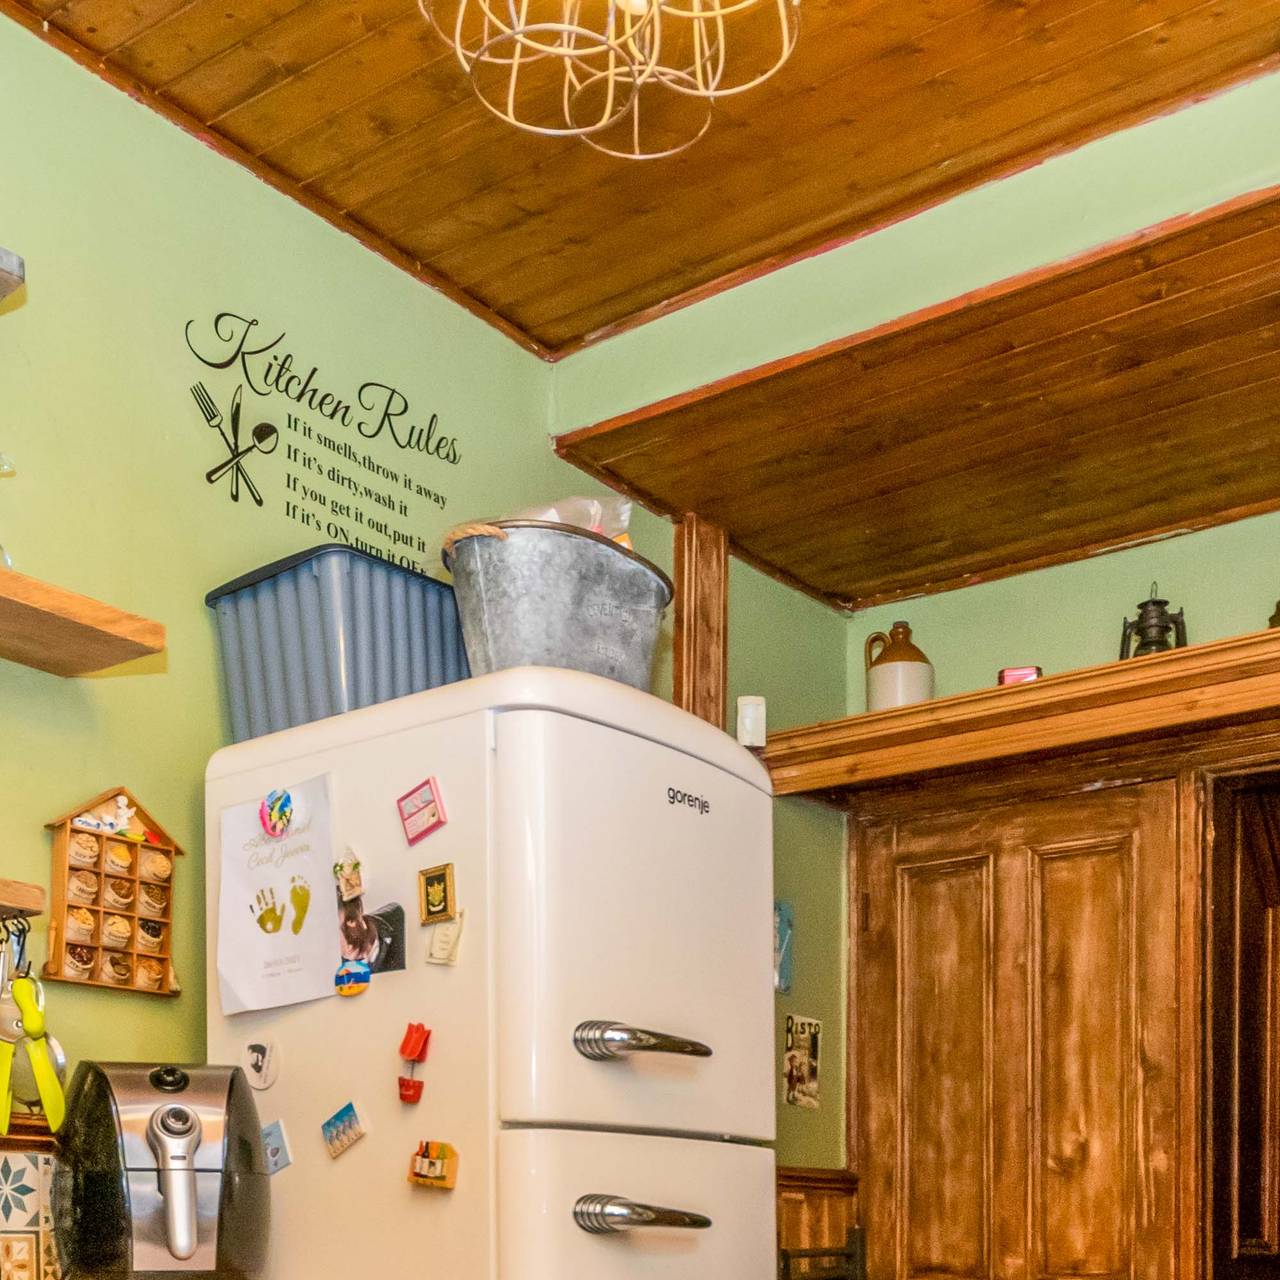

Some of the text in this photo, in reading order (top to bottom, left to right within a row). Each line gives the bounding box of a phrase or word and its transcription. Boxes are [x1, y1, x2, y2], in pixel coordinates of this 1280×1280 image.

[185, 312, 462, 465] Kitchen Rules
[287, 413, 299, 432] If
[303, 422, 312, 440] it
[403, 473, 412, 490] it
[416, 483, 448, 510] away
[287, 444, 299, 462] If
[303, 452, 323, 476] it's
[400, 500, 408, 518] it
[286, 501, 298, 520] If
[301, 509, 321, 531] it's
[287, 473, 299, 492] If
[302, 485, 326, 507] you
[331, 499, 351, 518] get
[355, 507, 363, 524] it
[417, 537, 426, 553] it
[667, 787, 710, 815] gorenje
[786, 1015, 820, 1051] BISTO
